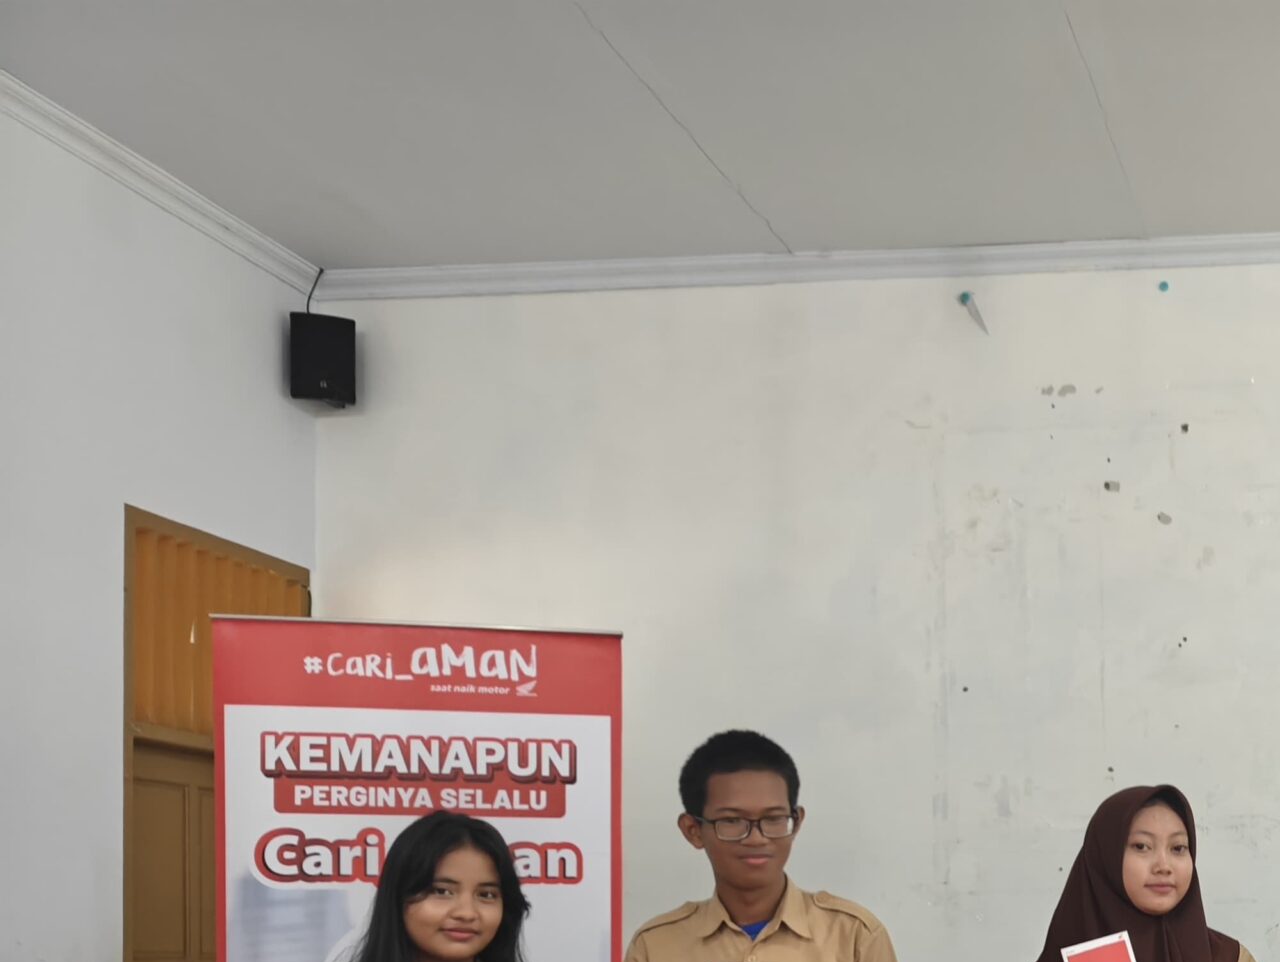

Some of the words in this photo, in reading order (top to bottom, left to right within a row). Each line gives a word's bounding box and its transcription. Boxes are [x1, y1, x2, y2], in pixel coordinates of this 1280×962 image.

[430, 684, 452, 692] saat
[453, 684, 476, 693] naik
[478, 684, 511, 694] motor
[264, 734, 570, 777] KEMANAPUN
[294, 785, 434, 810] PERGINYA
[439, 788, 548, 811] SELALU
